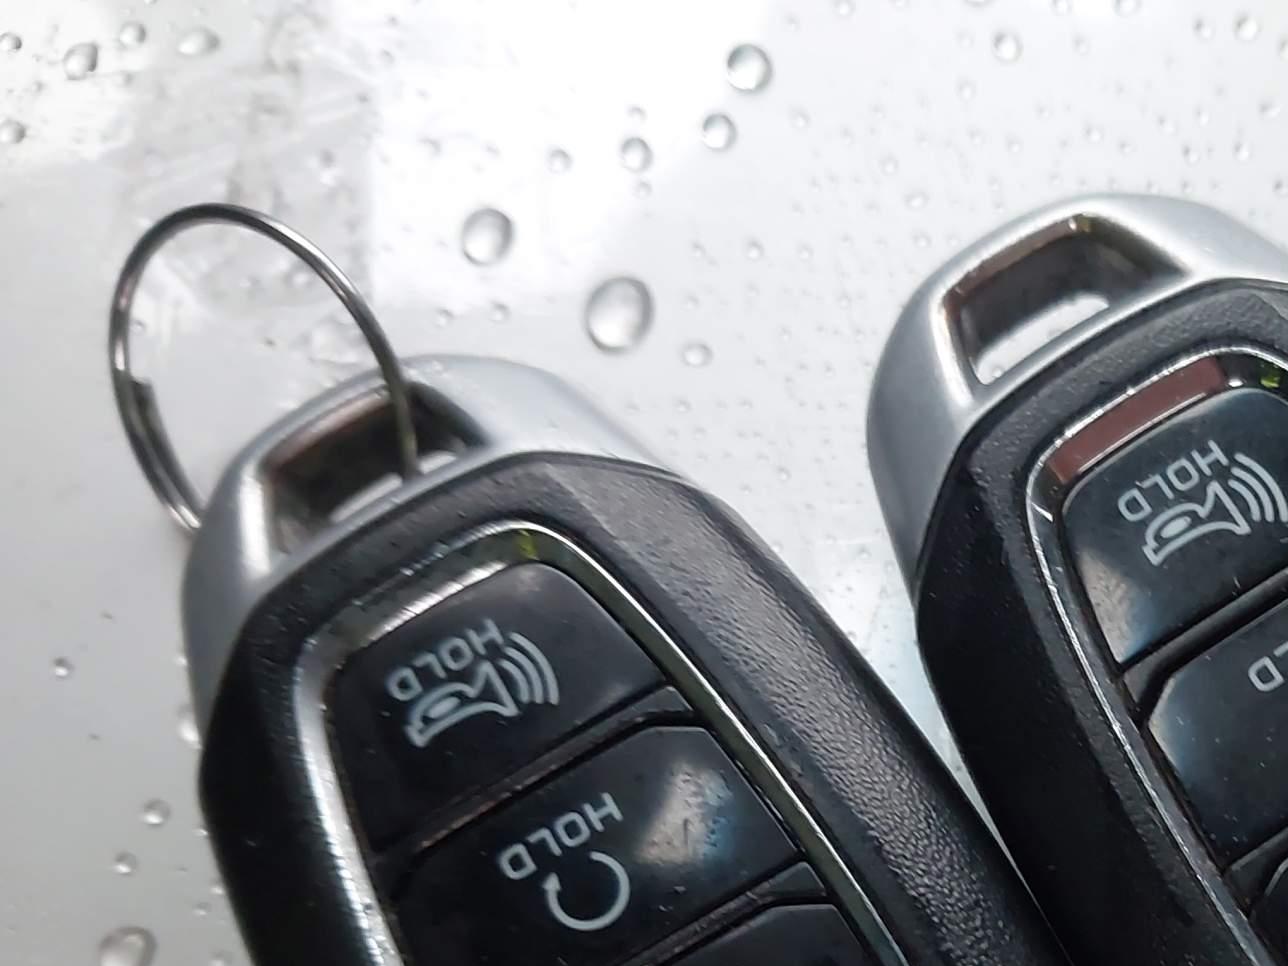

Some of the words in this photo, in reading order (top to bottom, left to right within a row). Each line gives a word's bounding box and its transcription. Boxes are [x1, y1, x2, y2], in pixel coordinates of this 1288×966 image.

[1117, 440, 1229, 522] HOLD
[386, 618, 503, 700] HOLD
[498, 792, 623, 880] HOLD
